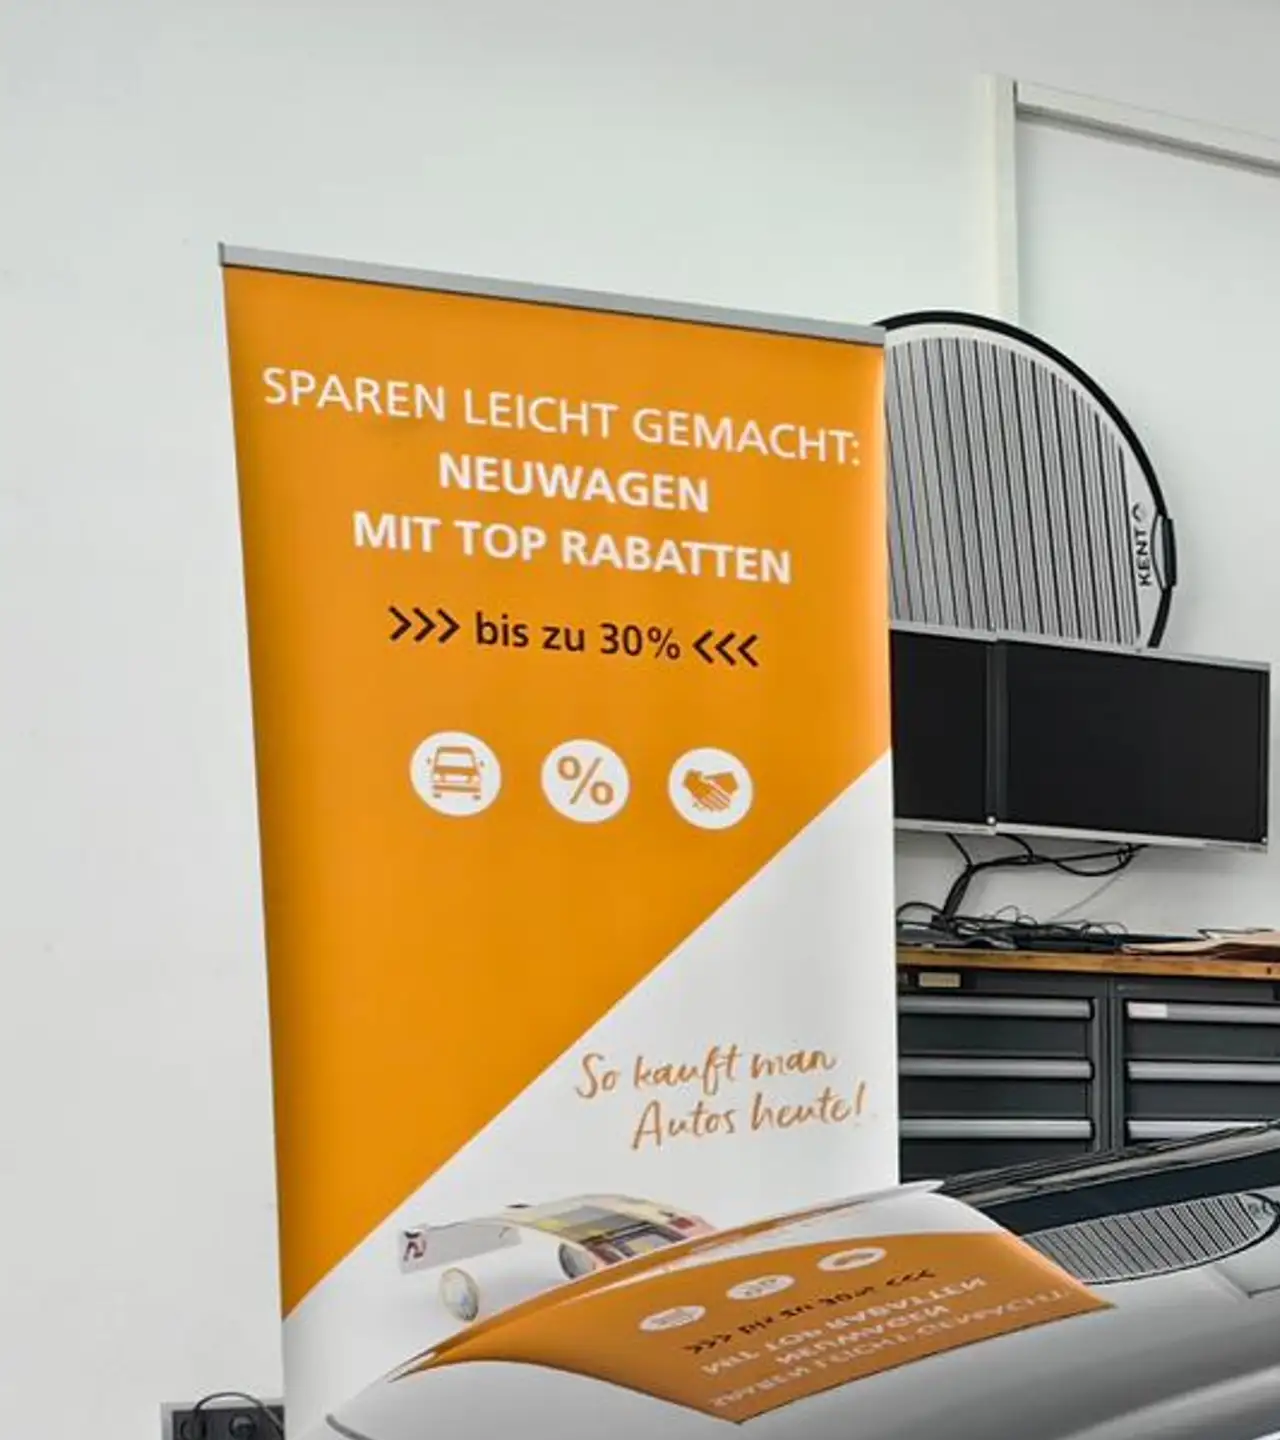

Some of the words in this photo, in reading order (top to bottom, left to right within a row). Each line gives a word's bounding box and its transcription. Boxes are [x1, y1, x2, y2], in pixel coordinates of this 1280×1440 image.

[263, 366, 447, 422] SPAREN
[464, 388, 619, 440] LEICHT
[632, 408, 861, 467] GEMACHT:
[438, 452, 710, 513] NEUWAGEN
[352, 510, 441, 553] MIT
[454, 519, 546, 561] TOP
[561, 530, 792, 584] RABATTEN
[1134, 528, 1152, 586] KENT
[475, 611, 529, 649] bis
[542, 623, 586, 653] zu
[599, 622, 682, 661] 30%
[575, 1052, 620, 1100] So
[633, 1043, 743, 1097] kauft
[750, 1048, 837, 1080] man
[630, 1098, 737, 1151] Autos
[750, 1081, 867, 1130] heute!
